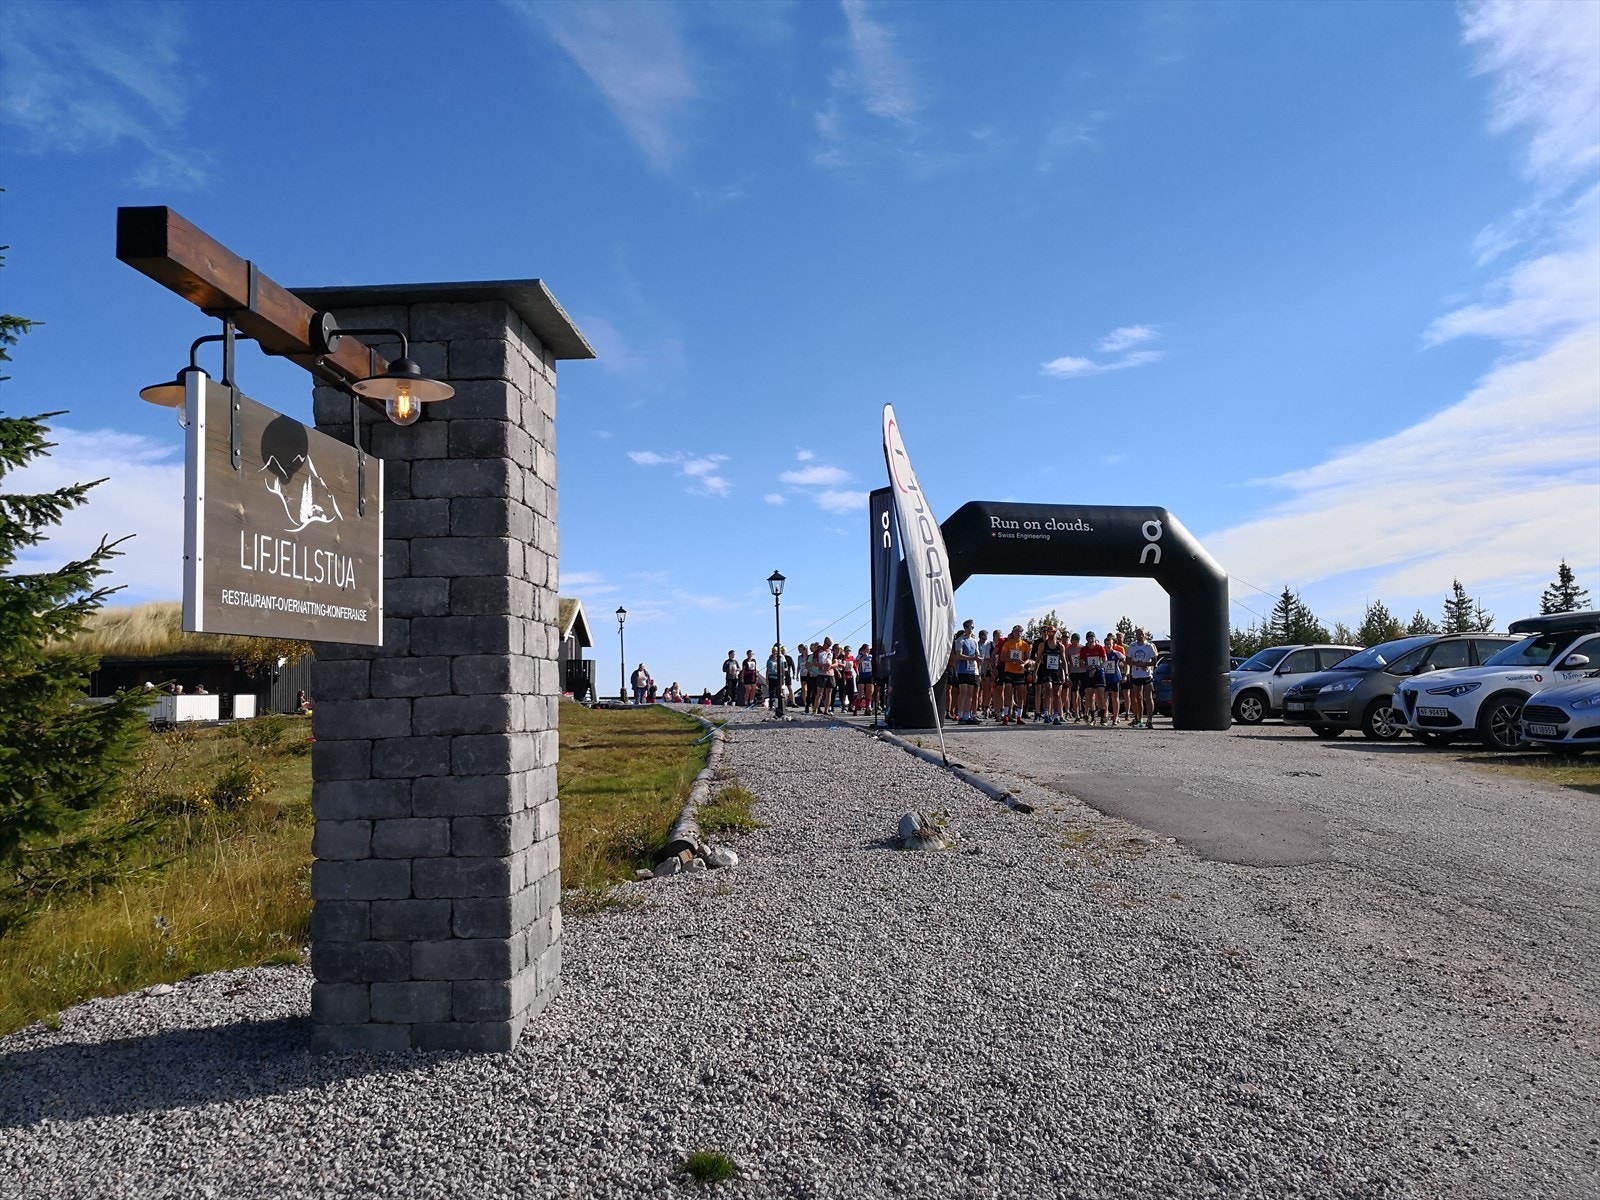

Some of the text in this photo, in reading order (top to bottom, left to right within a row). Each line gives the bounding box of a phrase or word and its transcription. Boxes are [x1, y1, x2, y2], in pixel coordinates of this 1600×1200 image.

[990, 516, 1094, 532] Run on clouds.
[1016, 532, 1051, 541] Engineering
[240, 530, 356, 590] LIFJELLSTUA
